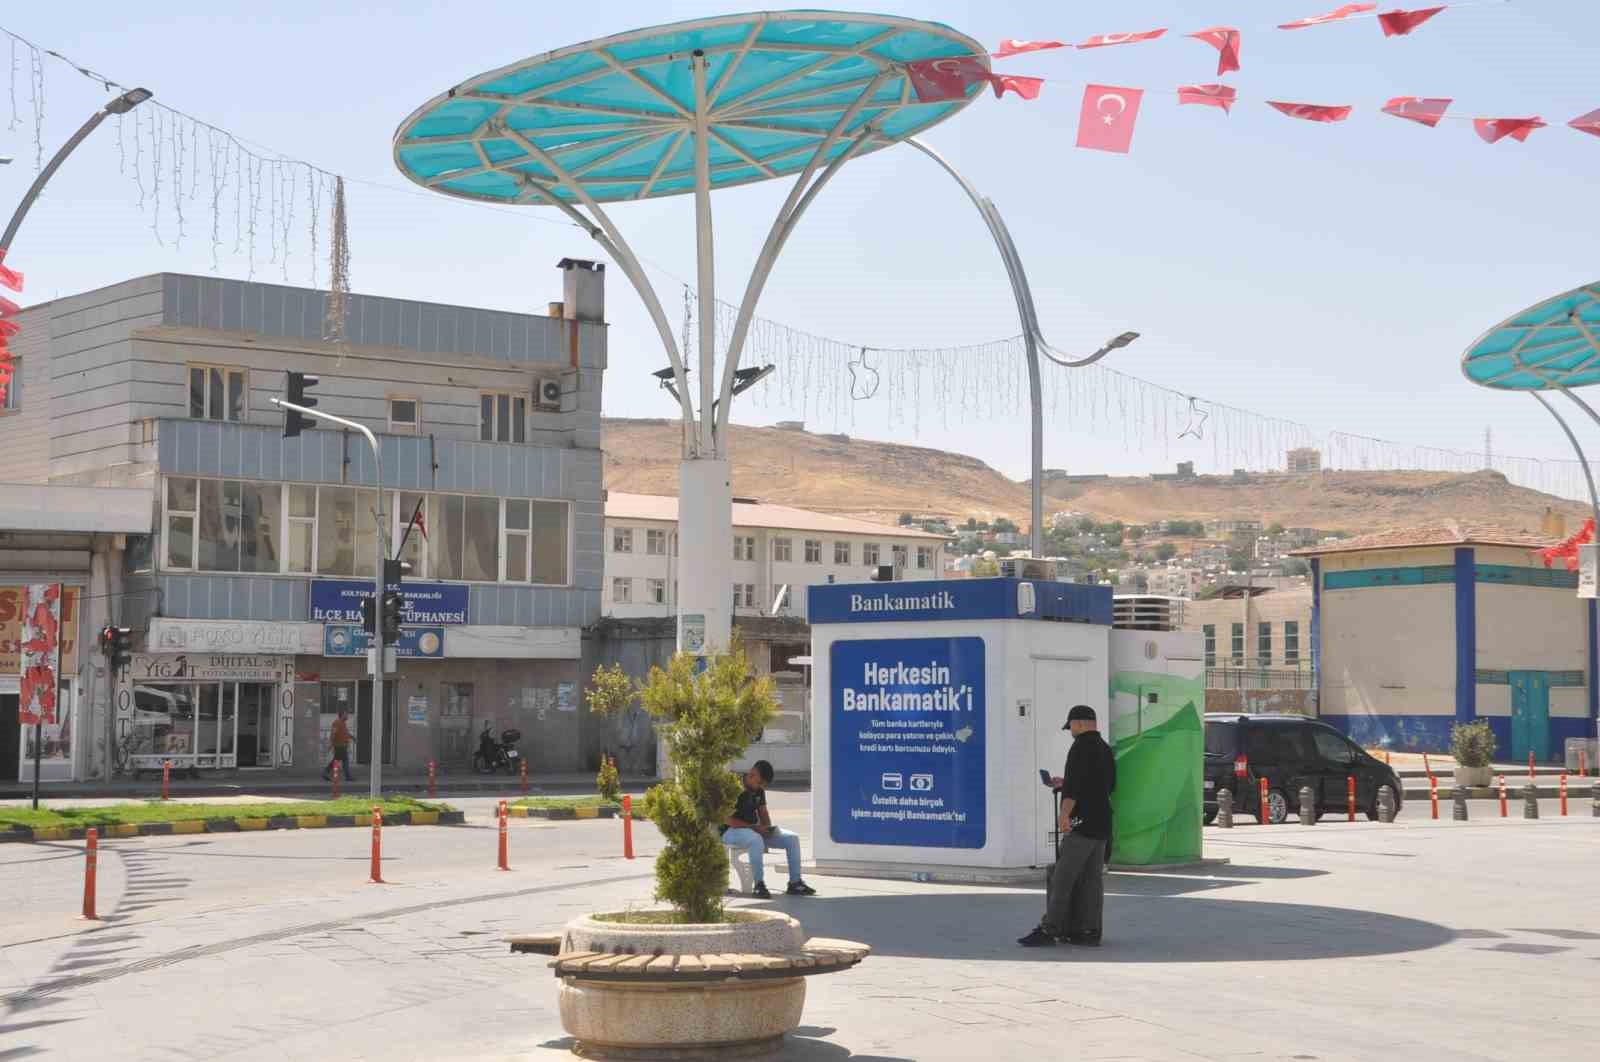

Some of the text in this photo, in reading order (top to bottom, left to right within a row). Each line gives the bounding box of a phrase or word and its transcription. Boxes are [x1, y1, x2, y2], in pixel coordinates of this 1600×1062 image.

[851, 591, 955, 612] Bankamatik
[864, 661, 950, 685] Herkesin
[843, 684, 973, 711] Bankamatik'i
[281, 663, 294, 765] FOTO
[871, 719, 944, 730] Tüm banka kartlarıyla
[859, 731, 885, 741] kolayca
[886, 733, 901, 741] para
[903, 732, 924, 741] yatırın
[860, 743, 877, 752] kredi
[878, 743, 894, 752] kartı
[895, 744, 931, 753] borcunuzu
[872, 793, 944, 808] Üstelik daha birçok
[872, 810, 906, 821] seçeneği
